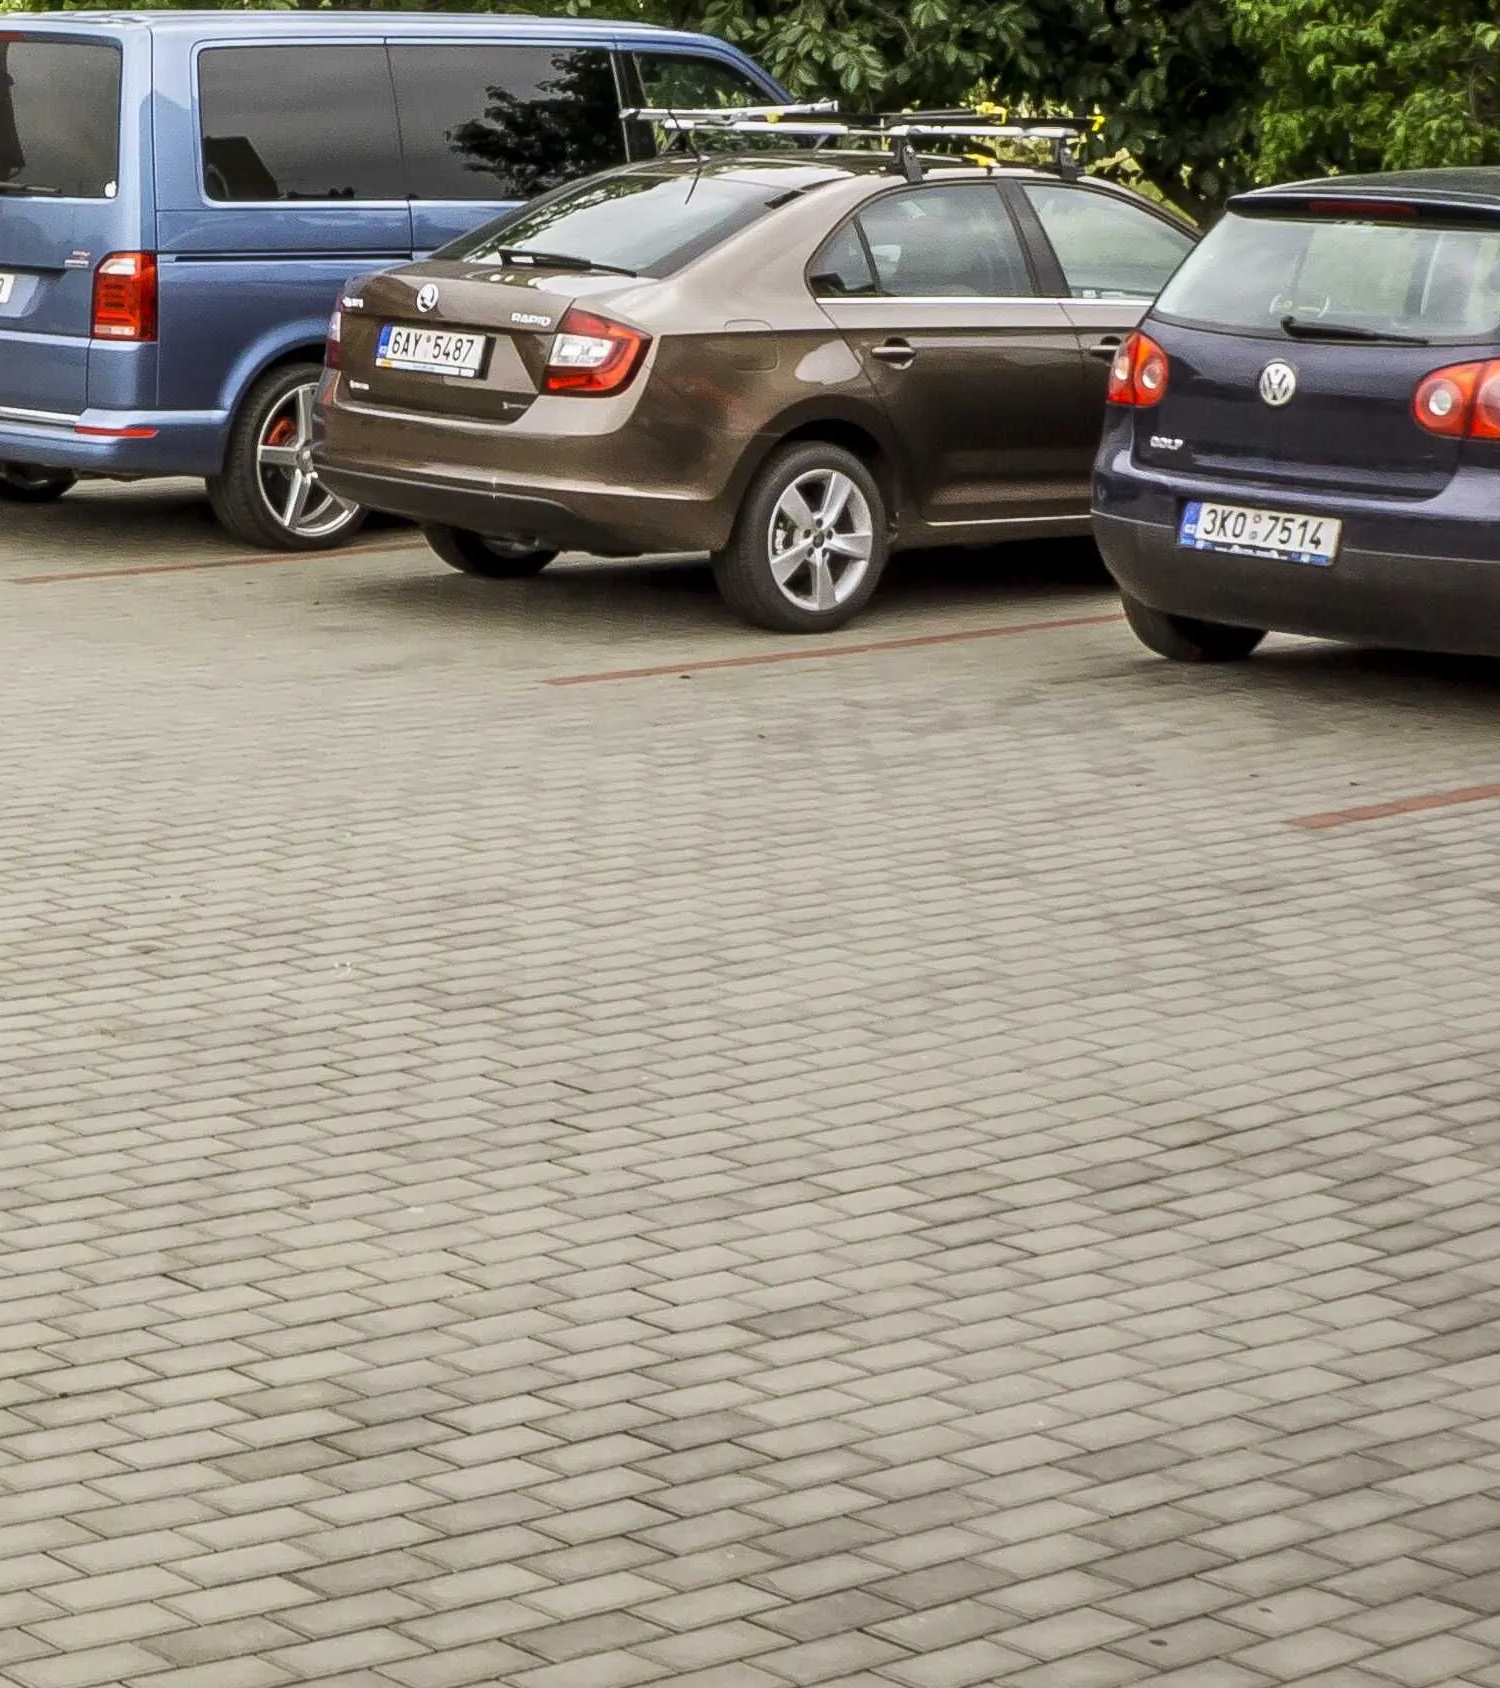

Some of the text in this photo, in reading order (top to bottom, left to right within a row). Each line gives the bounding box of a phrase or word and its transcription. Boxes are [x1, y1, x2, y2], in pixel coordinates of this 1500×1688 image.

[511, 312, 551, 327] RAPID
[392, 331, 475, 363] 6AY 5487
[1203, 508, 1324, 550] 3K0 7514
